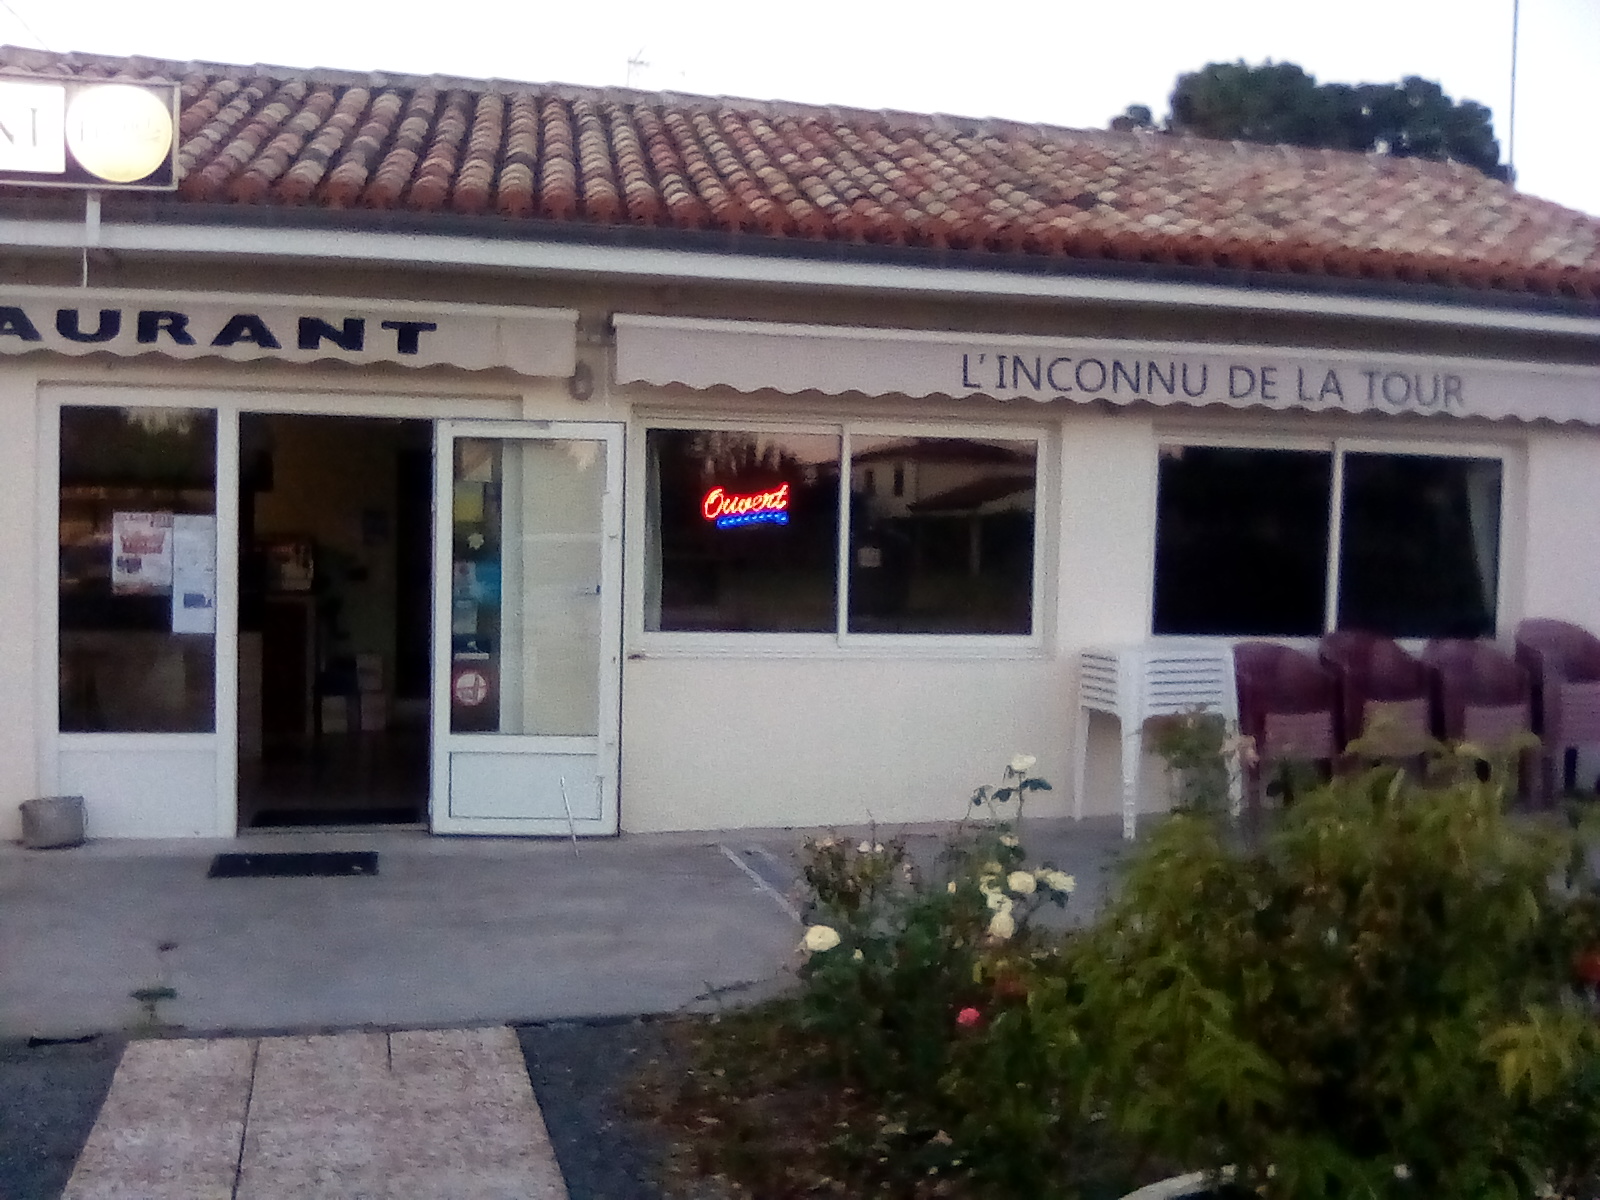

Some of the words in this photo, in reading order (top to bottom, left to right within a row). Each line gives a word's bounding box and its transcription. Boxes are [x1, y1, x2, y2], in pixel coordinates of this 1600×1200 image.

[0, 306, 438, 354] AURANT
[962, 354, 1208, 397] L'INCONNU
[1229, 365, 1278, 400] DE
[1297, 366, 1344, 402] LA
[1360, 370, 1465, 408] TOUR
[703, 483, 789, 520] Ouvert
